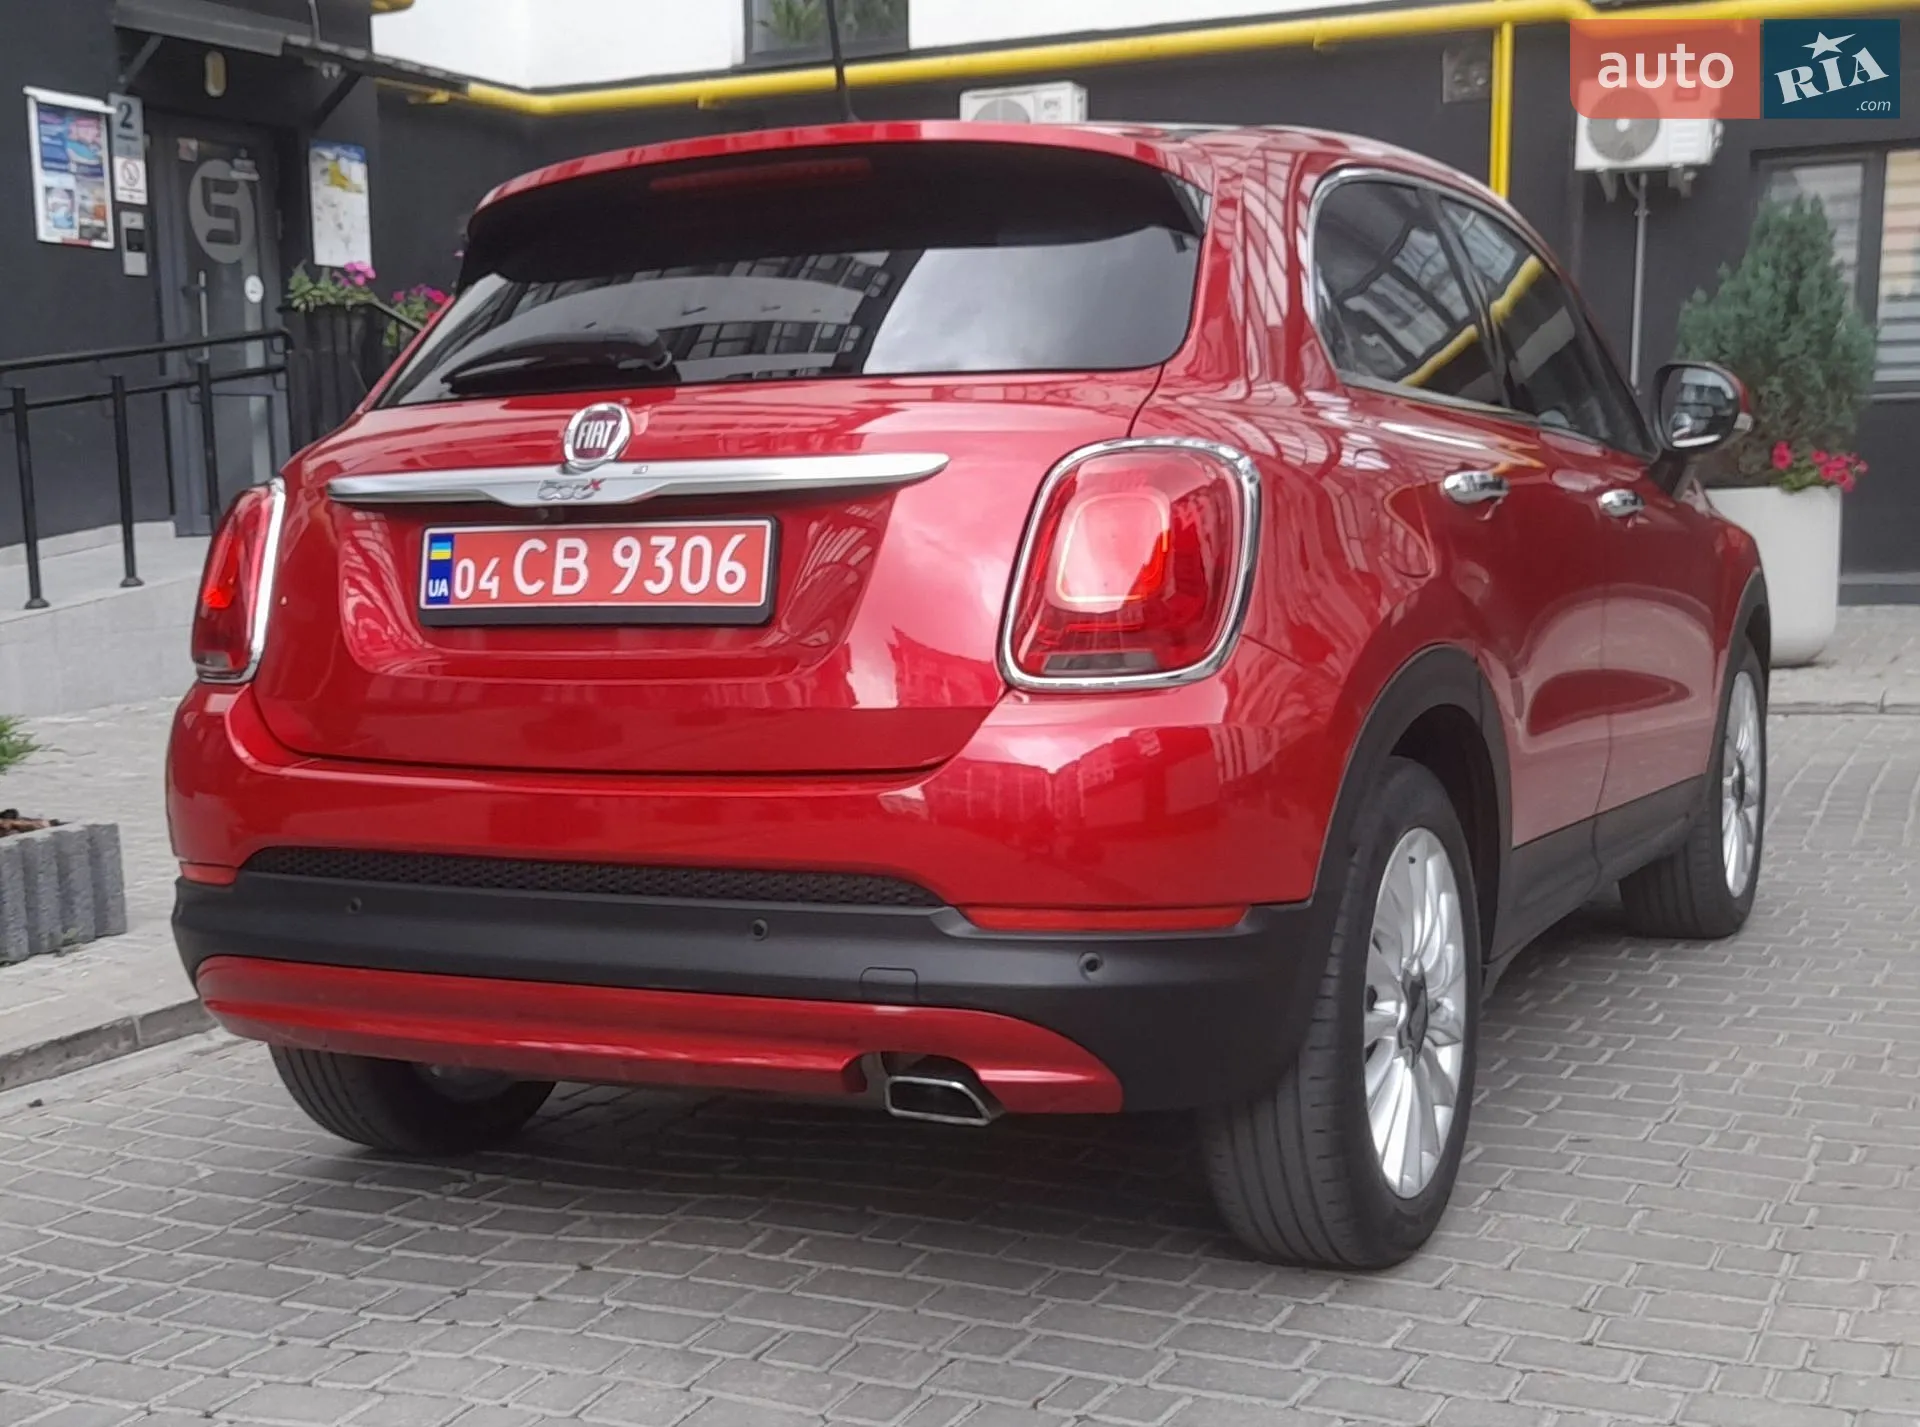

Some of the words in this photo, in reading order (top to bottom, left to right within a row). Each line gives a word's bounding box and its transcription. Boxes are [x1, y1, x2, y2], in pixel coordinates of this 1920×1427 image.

[118, 101, 134, 129] 2
[575, 420, 617, 449] FIAT
[454, 557, 500, 600] 04
[513, 538, 589, 595] CB
[610, 533, 747, 595] 9306
[428, 579, 449, 597] UA
